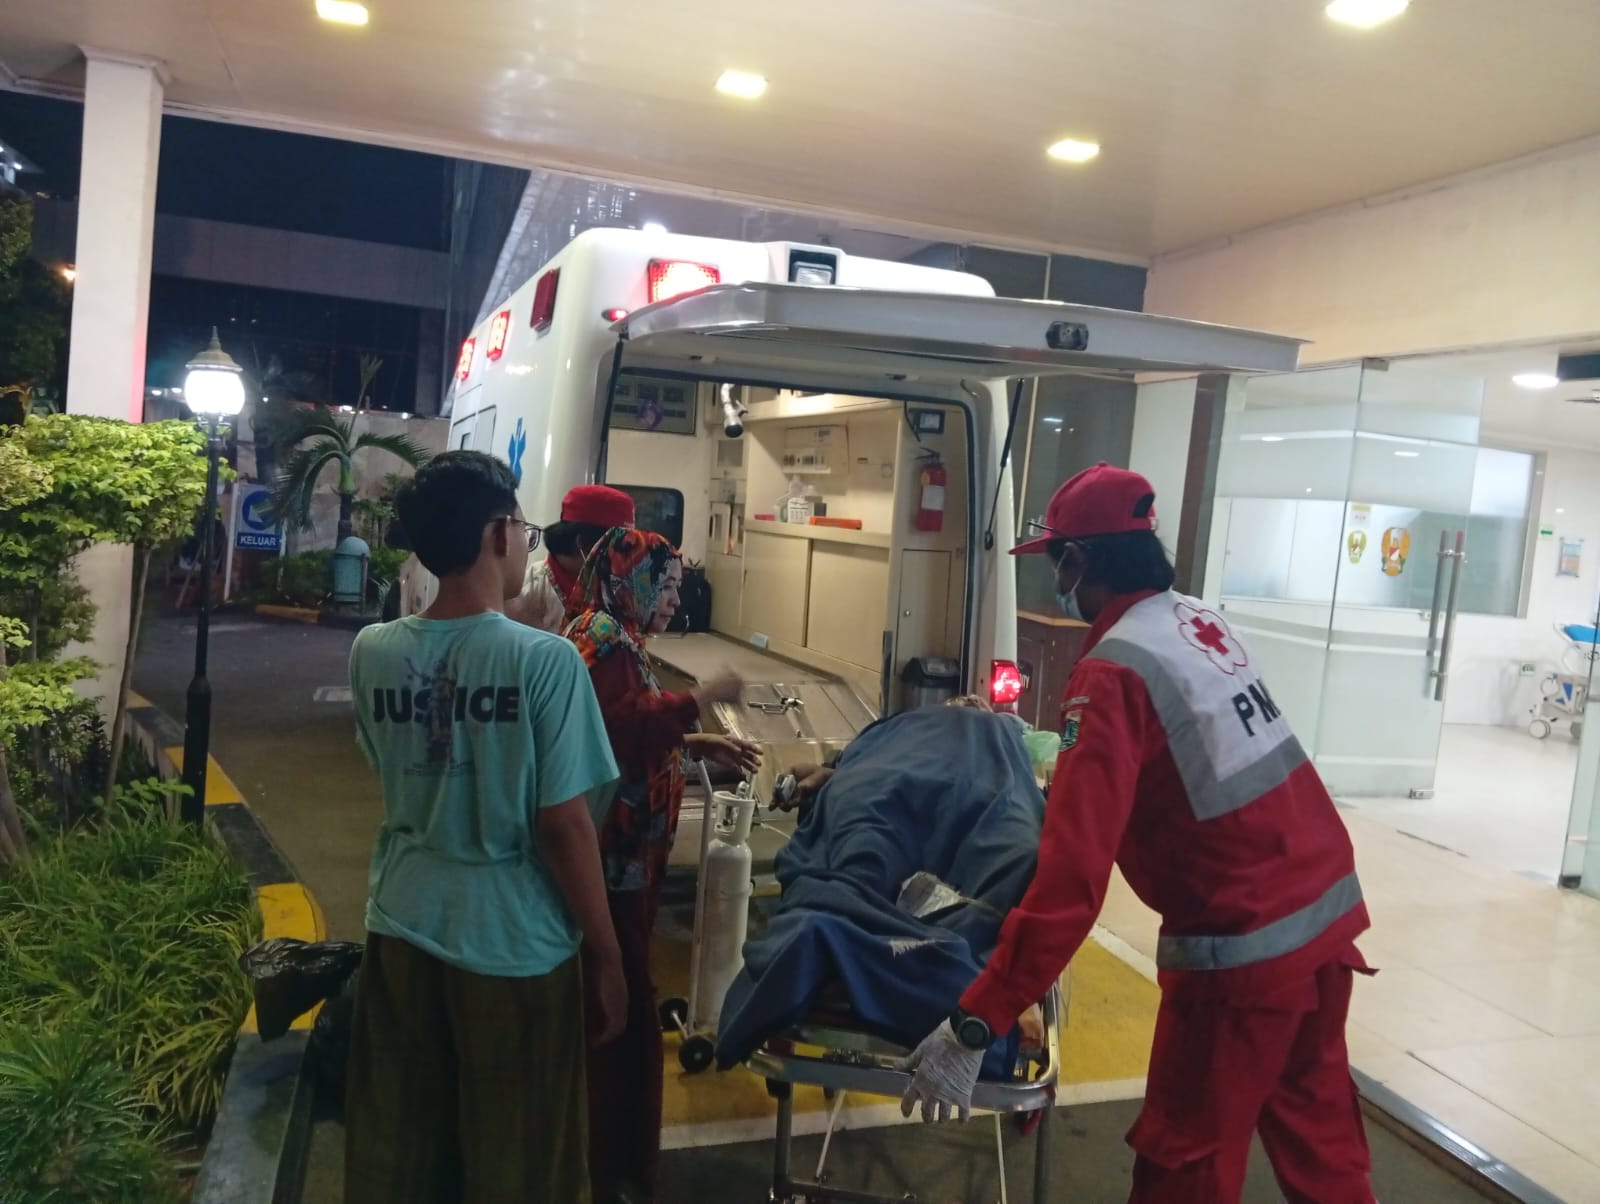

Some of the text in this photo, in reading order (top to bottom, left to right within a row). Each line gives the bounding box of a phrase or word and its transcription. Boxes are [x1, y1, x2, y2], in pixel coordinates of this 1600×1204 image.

[240, 534, 277, 546] KELUAR
[373, 686, 521, 724] JUSICE
[1232, 679, 1281, 737] PM
